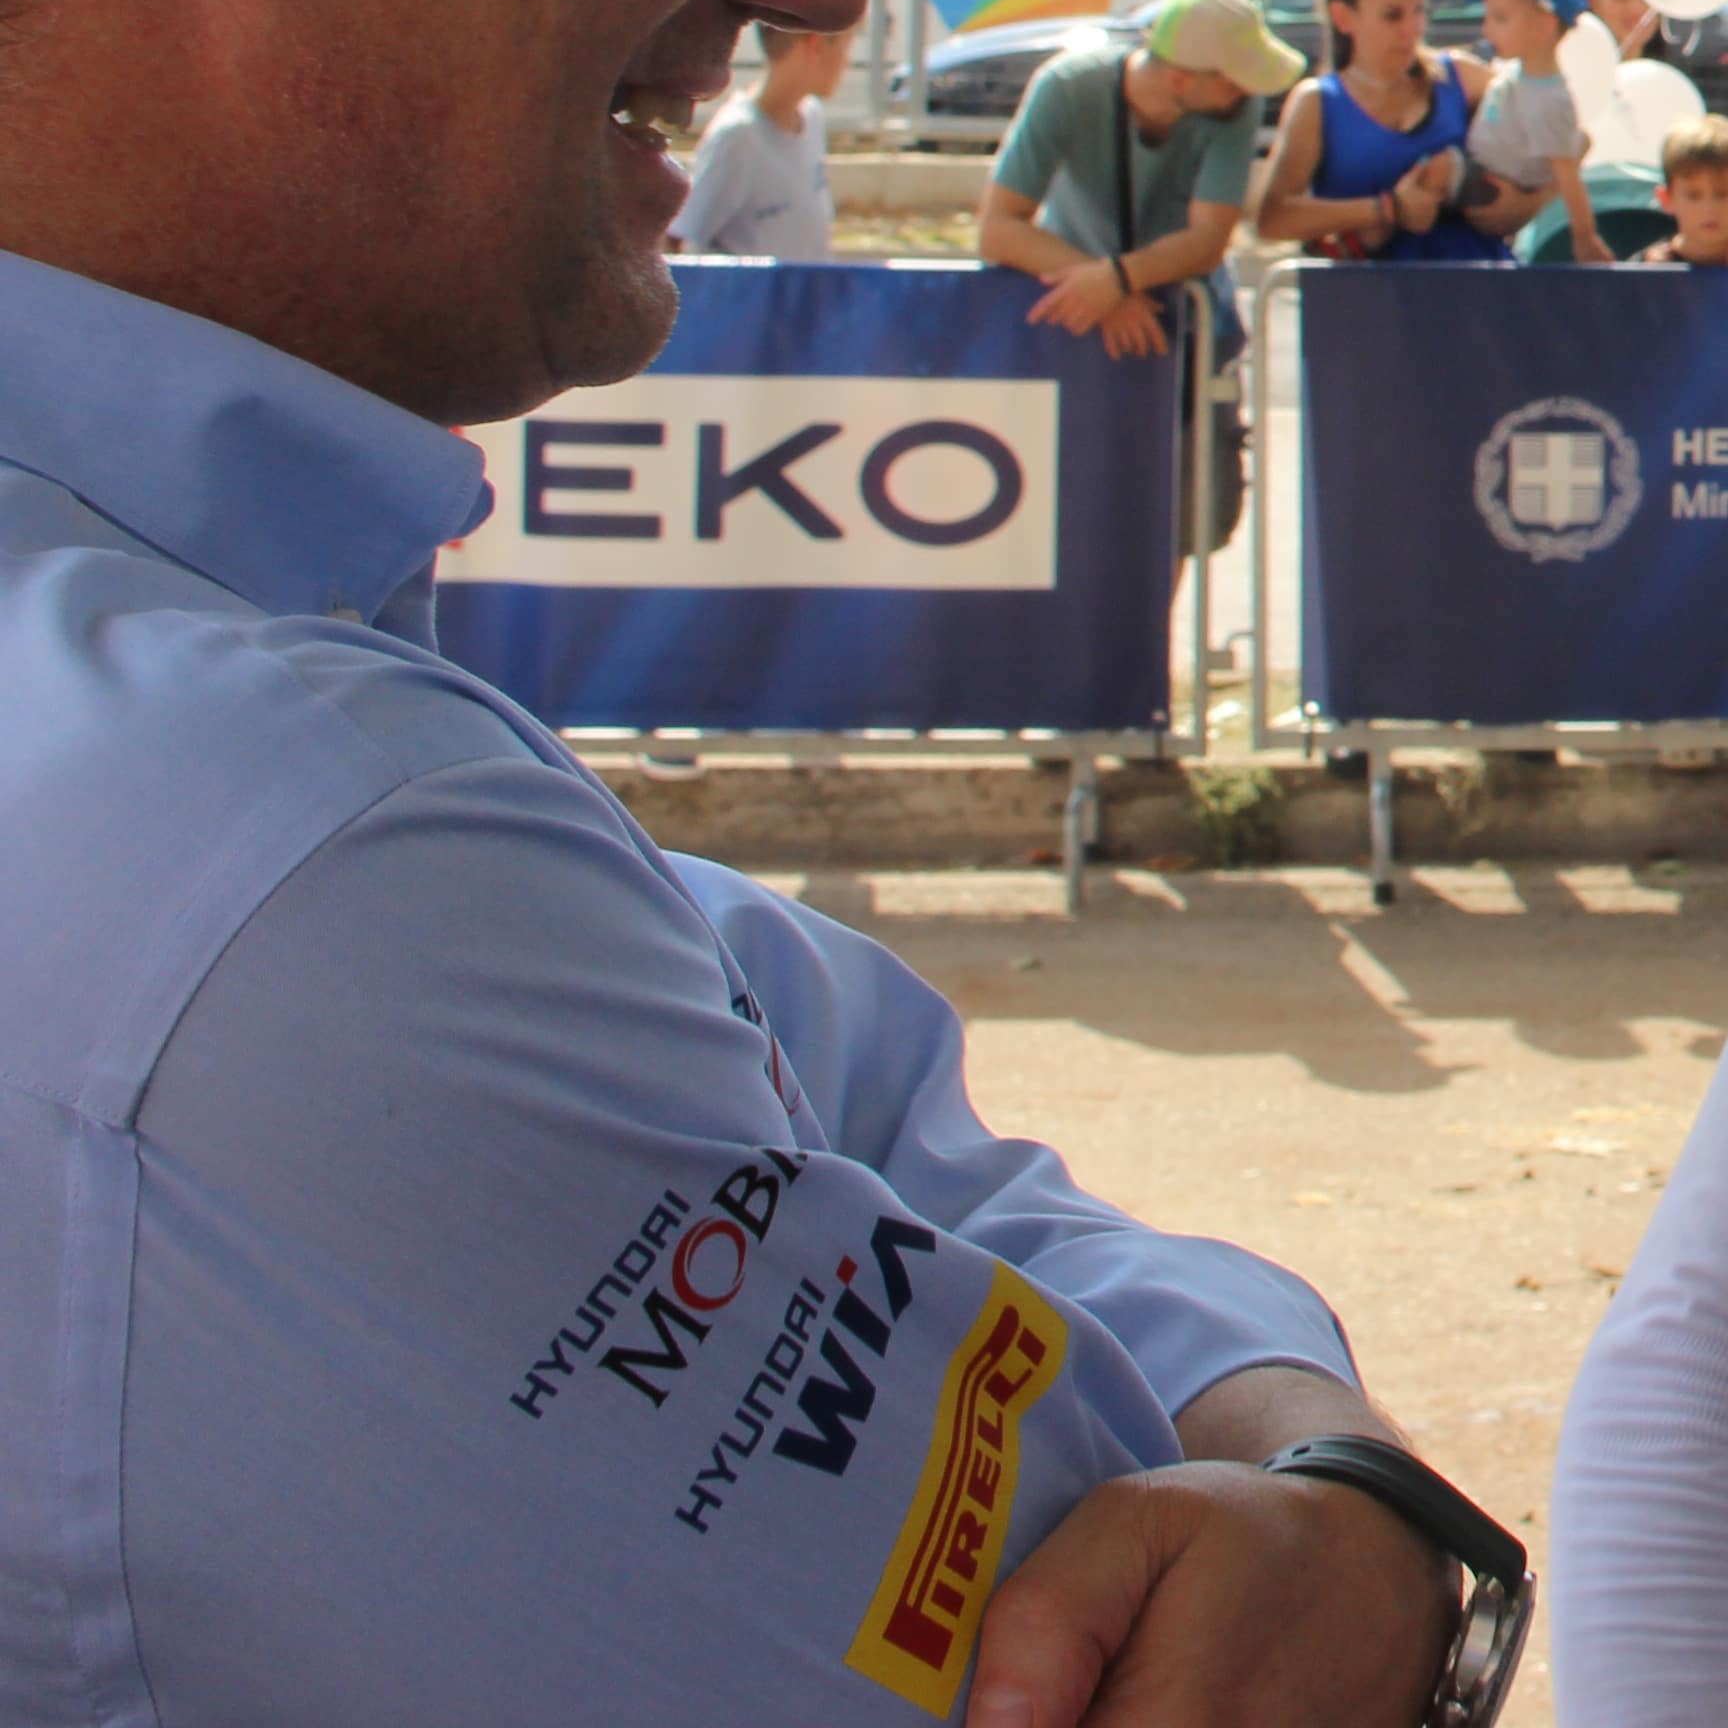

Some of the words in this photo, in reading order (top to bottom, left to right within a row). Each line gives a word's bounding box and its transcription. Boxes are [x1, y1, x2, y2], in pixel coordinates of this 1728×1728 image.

[509, 1188, 691, 1420] HYUNDAI
[598, 1147, 808, 1409] MOBI
[673, 1276, 828, 1535] HYUNDAI
[882, 1303, 1048, 1673] PIRELLI
